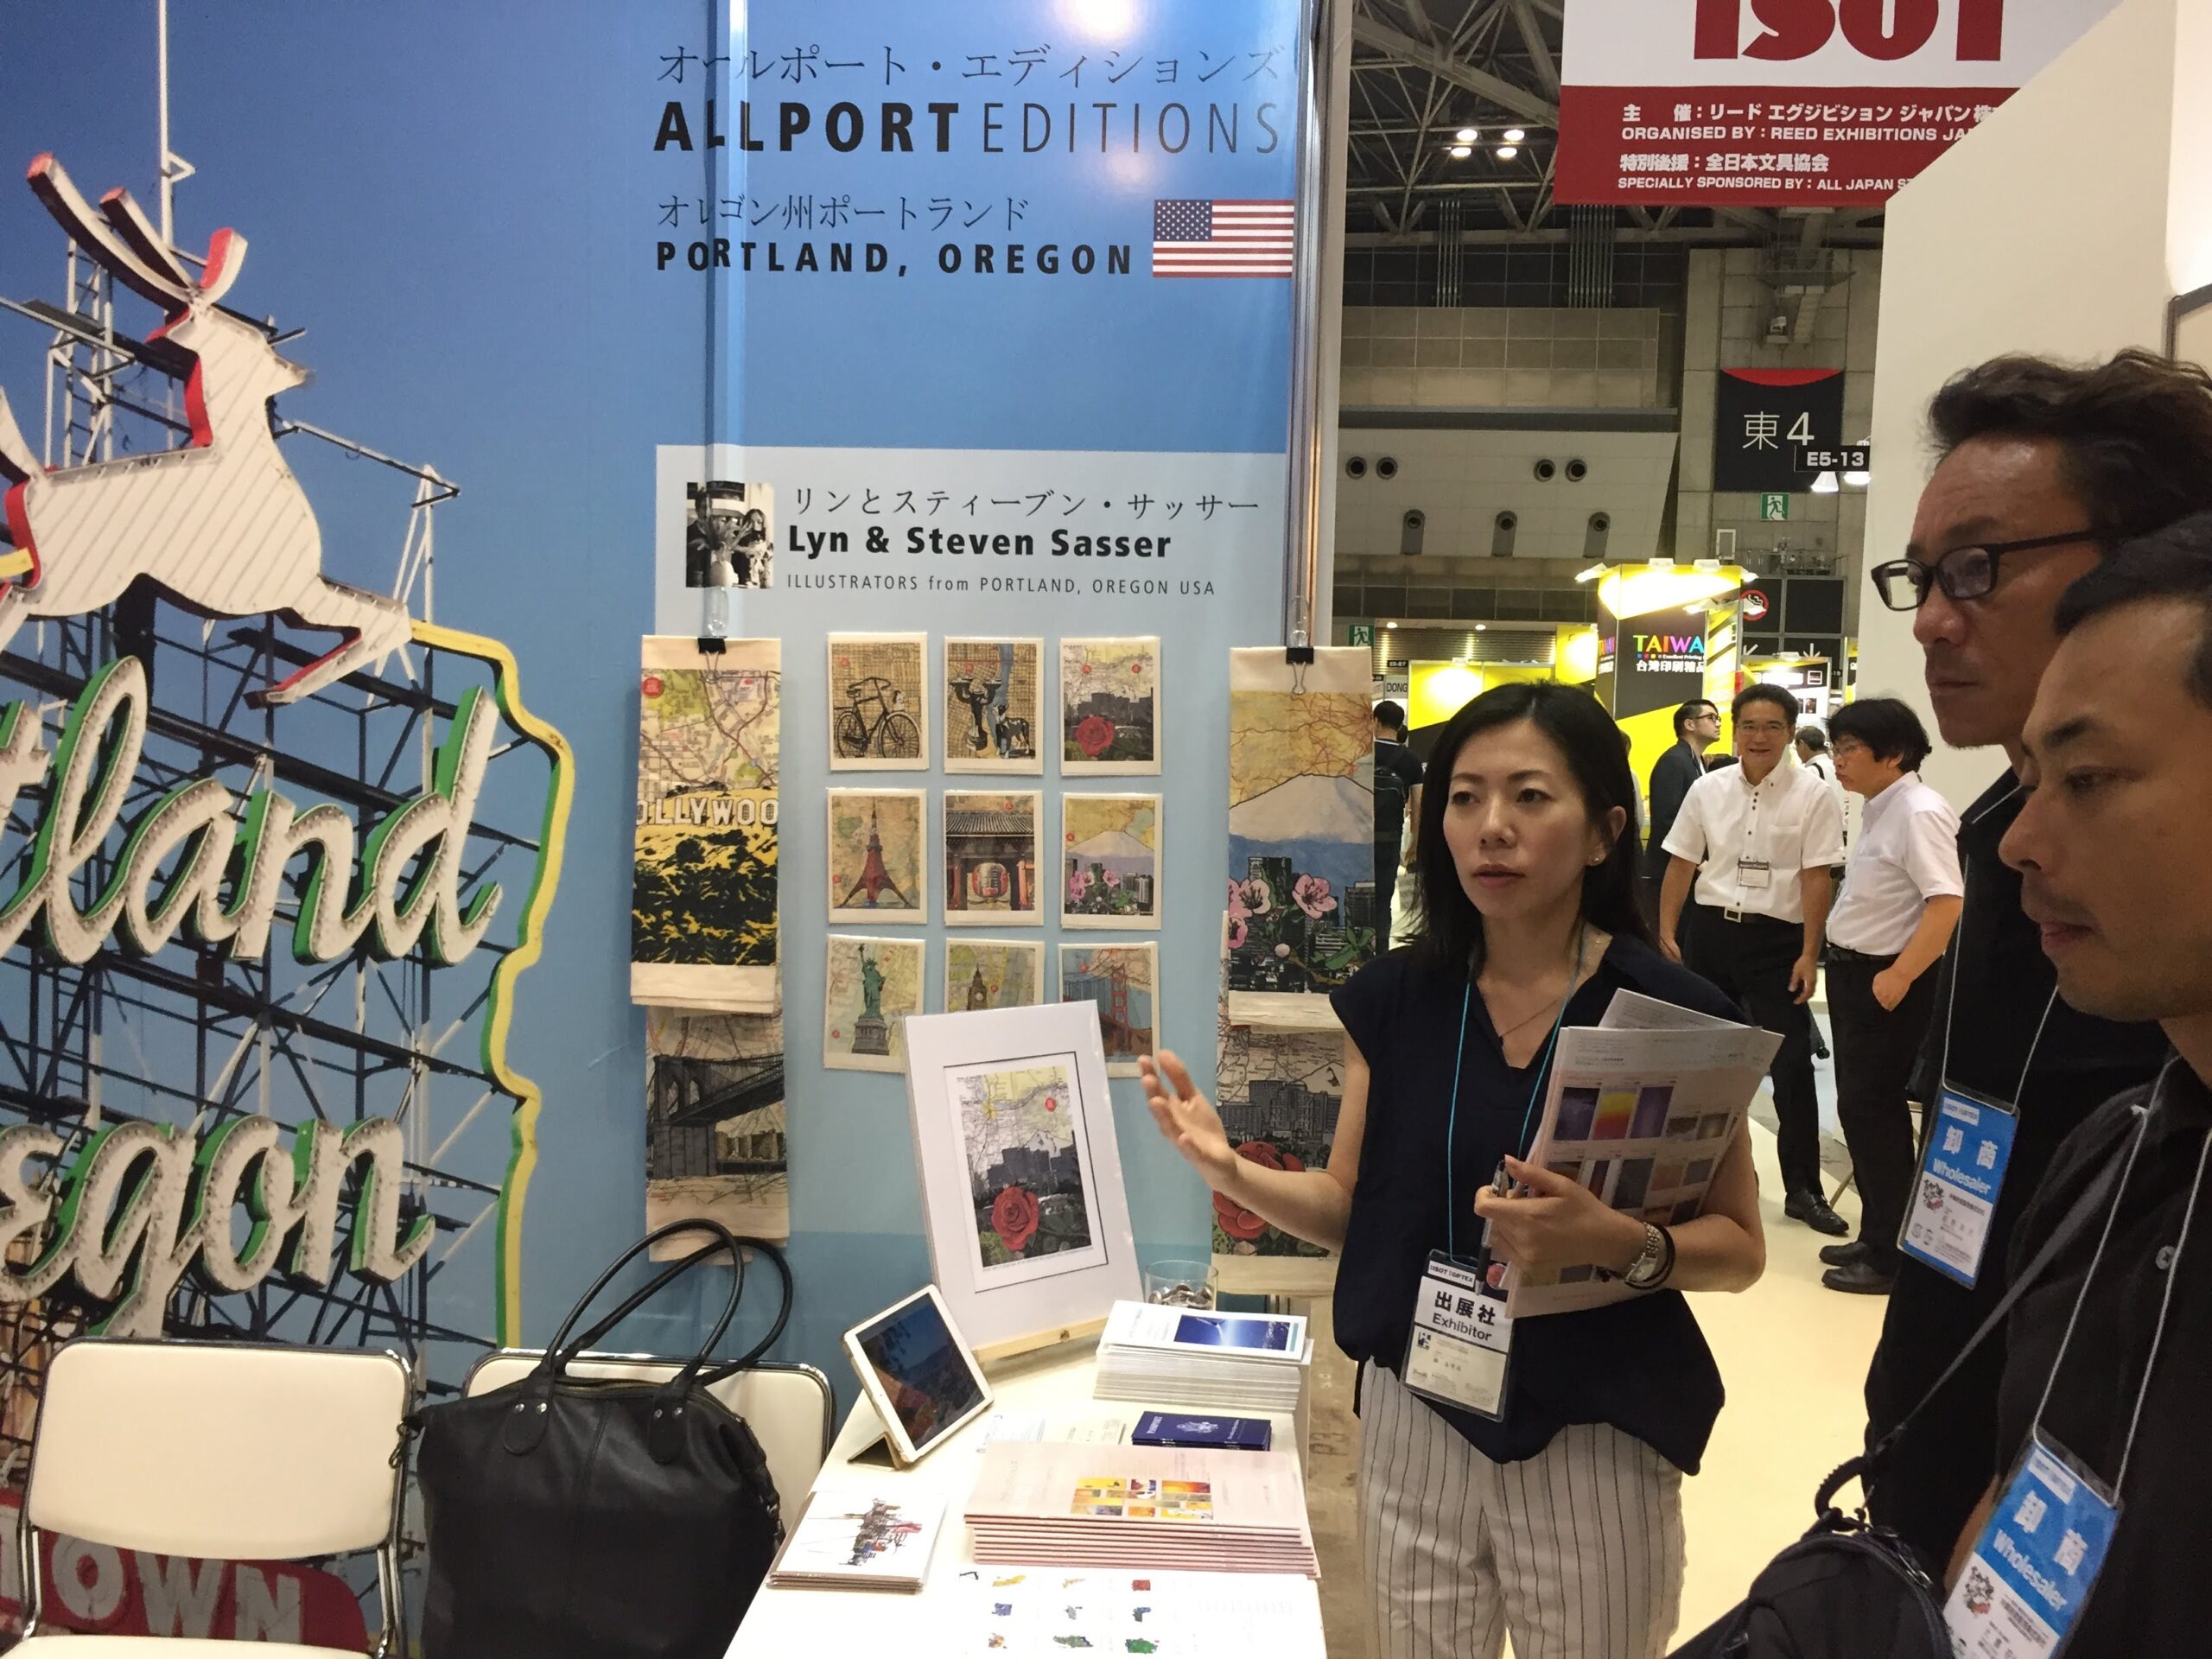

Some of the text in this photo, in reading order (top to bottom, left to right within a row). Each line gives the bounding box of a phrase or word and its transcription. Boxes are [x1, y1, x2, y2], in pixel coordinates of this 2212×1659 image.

[653, 101, 1280, 154] ALLPORT EDITIONS
[1767, 103, 1892, 124] エグジビション
[1899, 105, 2000, 124] ジャパン株
[1621, 126, 1727, 141] ORGANISED
[1770, 127, 1818, 141] REED
[1822, 127, 1938, 142] EXHIBITIONS
[1942, 128, 1974, 142] JA
[1618, 177, 1694, 189] SPECIALLY
[1696, 177, 1782, 190] SPONSORED
[1816, 180, 1842, 191] ALL
[1846, 180, 1894, 191] JAPAN
[658, 194, 1029, 232] オレゴン州ポートランド
[658, 238, 1132, 277] PORTLAND, OREGON
[1806, 451, 1865, 467] E5-13
[795, 487, 1260, 522] リンとスティーブン・サッサー
[788, 525, 1172, 559] Lyn & Steven Sasser
[787, 575, 1215, 595] ILLUSTRATORS from PORTLAND, OREGON USA
[1933, 1158, 1992, 1195] Wholesaler
[1434, 1291, 1496, 1326] 出展社
[1433, 1313, 1492, 1341] Exhibitor
